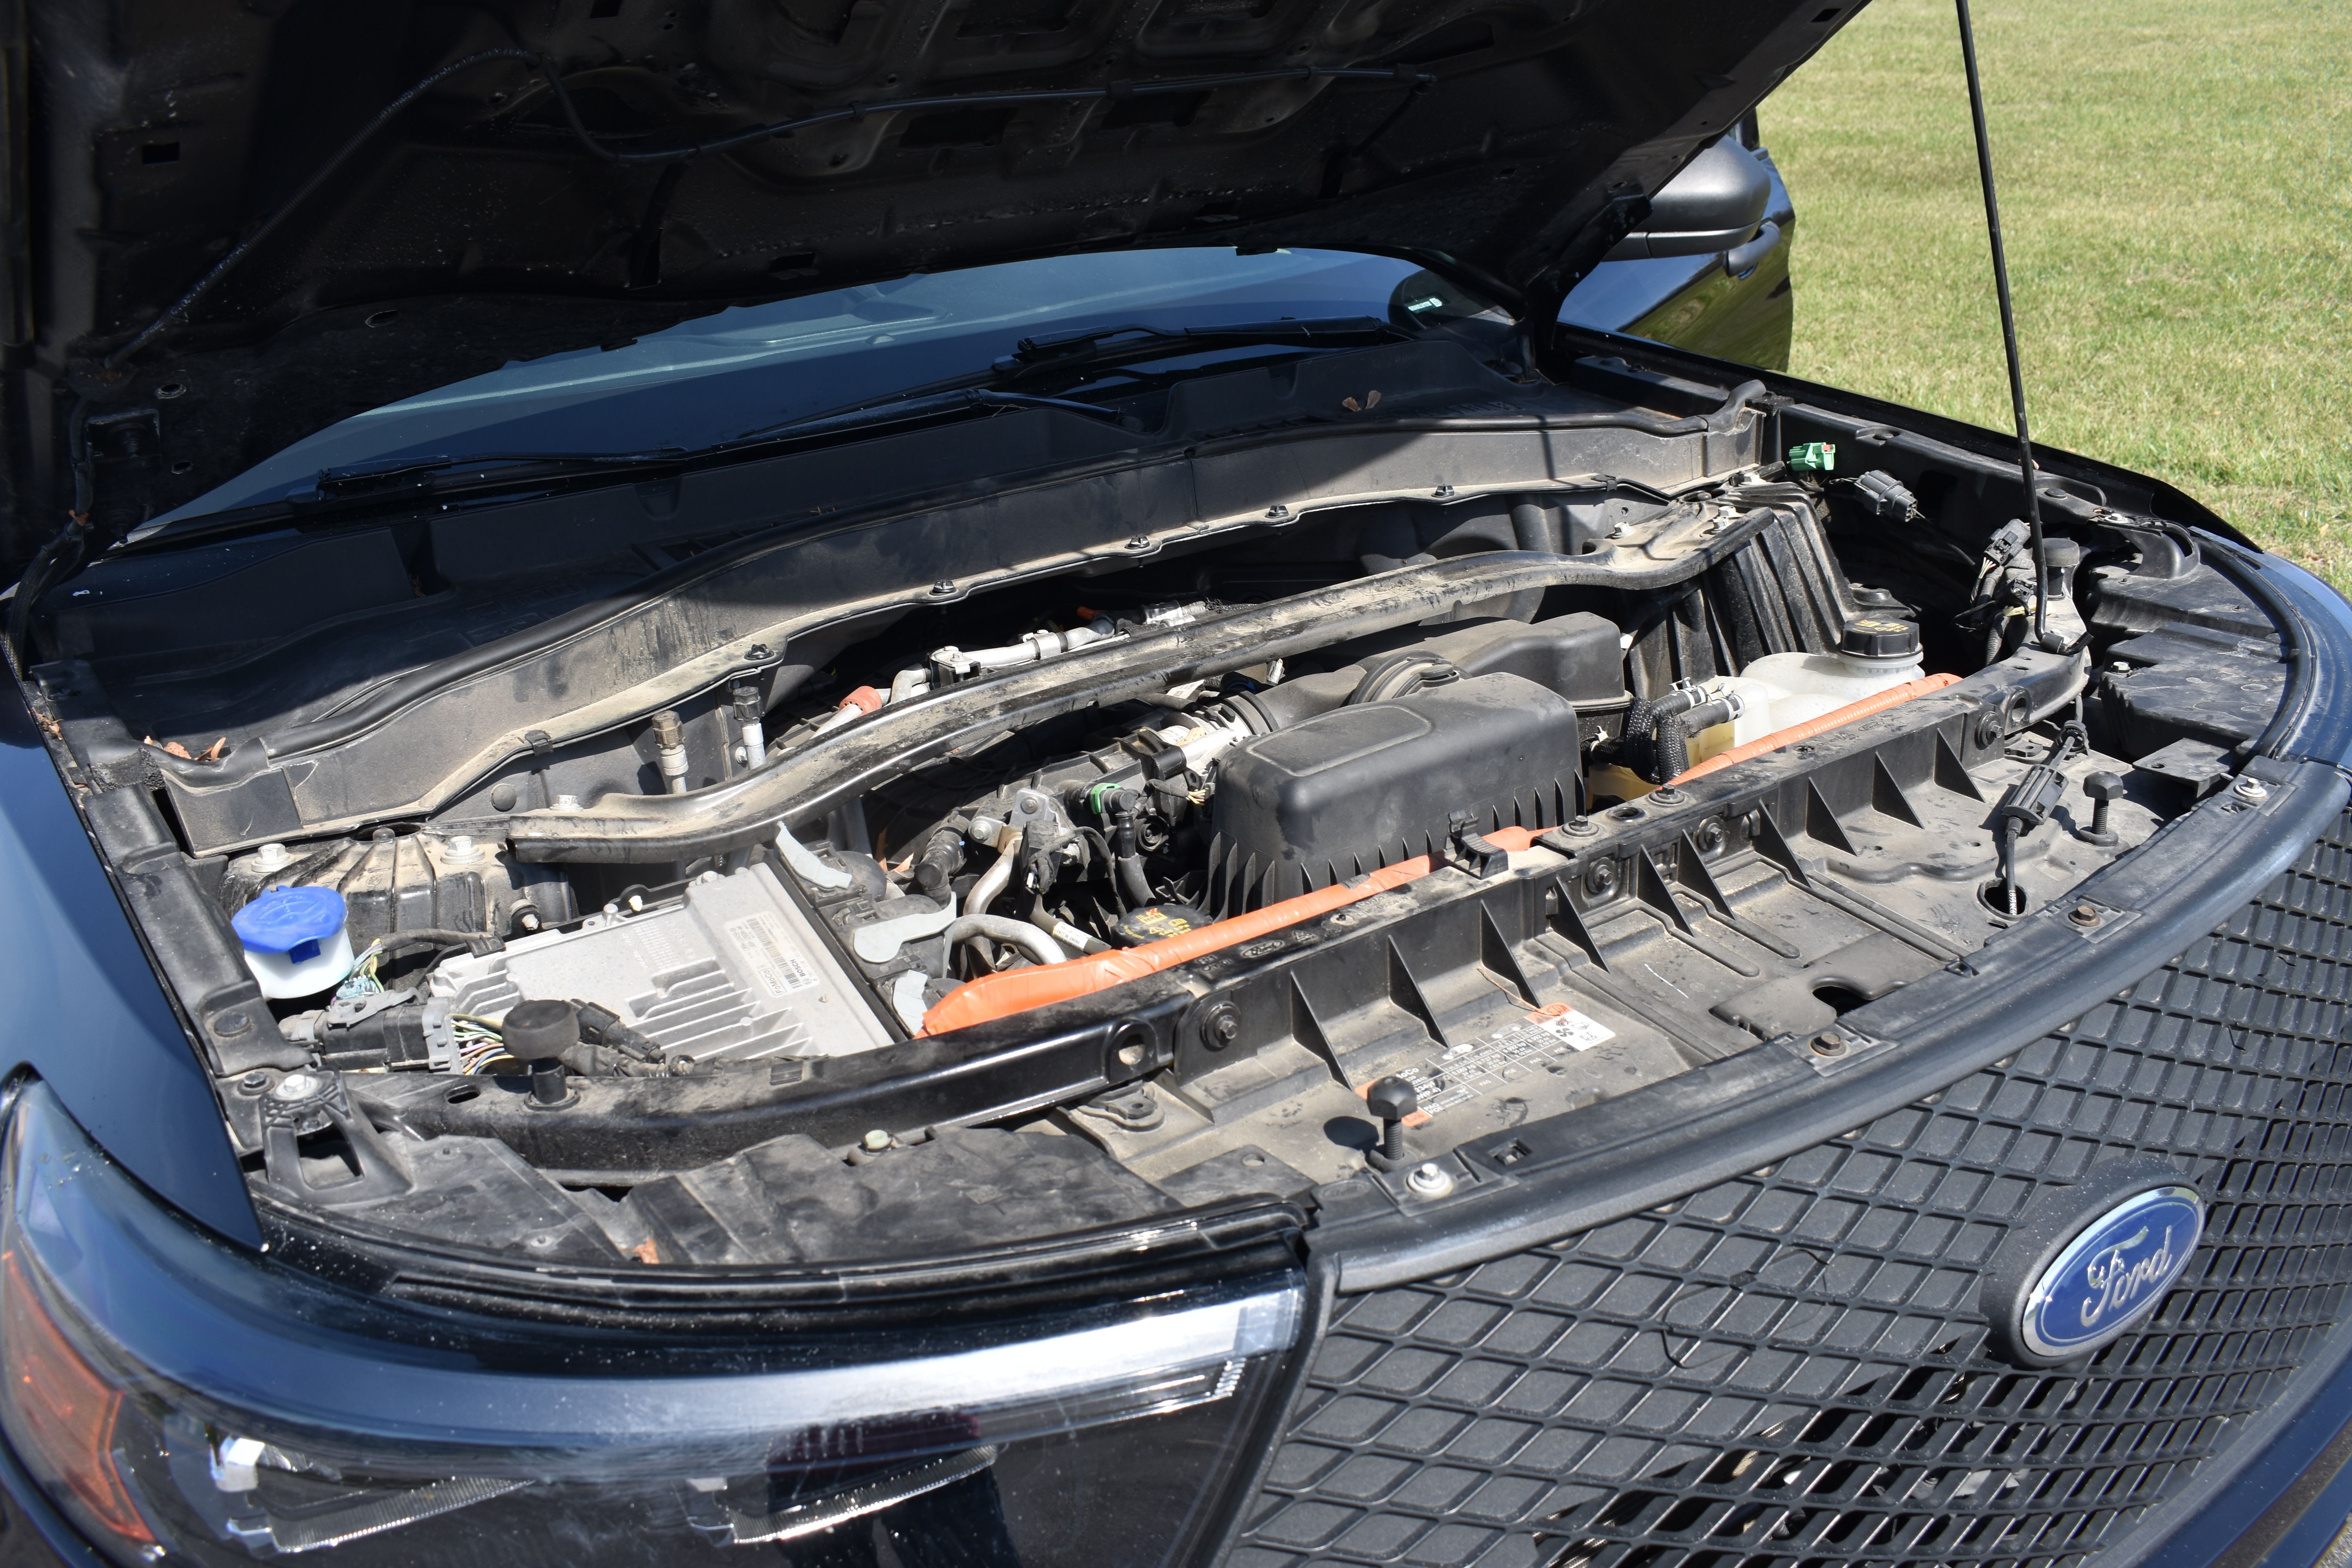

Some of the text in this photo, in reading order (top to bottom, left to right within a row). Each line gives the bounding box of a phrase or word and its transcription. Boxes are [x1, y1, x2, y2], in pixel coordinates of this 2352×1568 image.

[789, 958, 806, 977] BOSCH
[764, 969, 783, 994] FoMoCo
[2080, 1225, 2173, 1327] Ford
